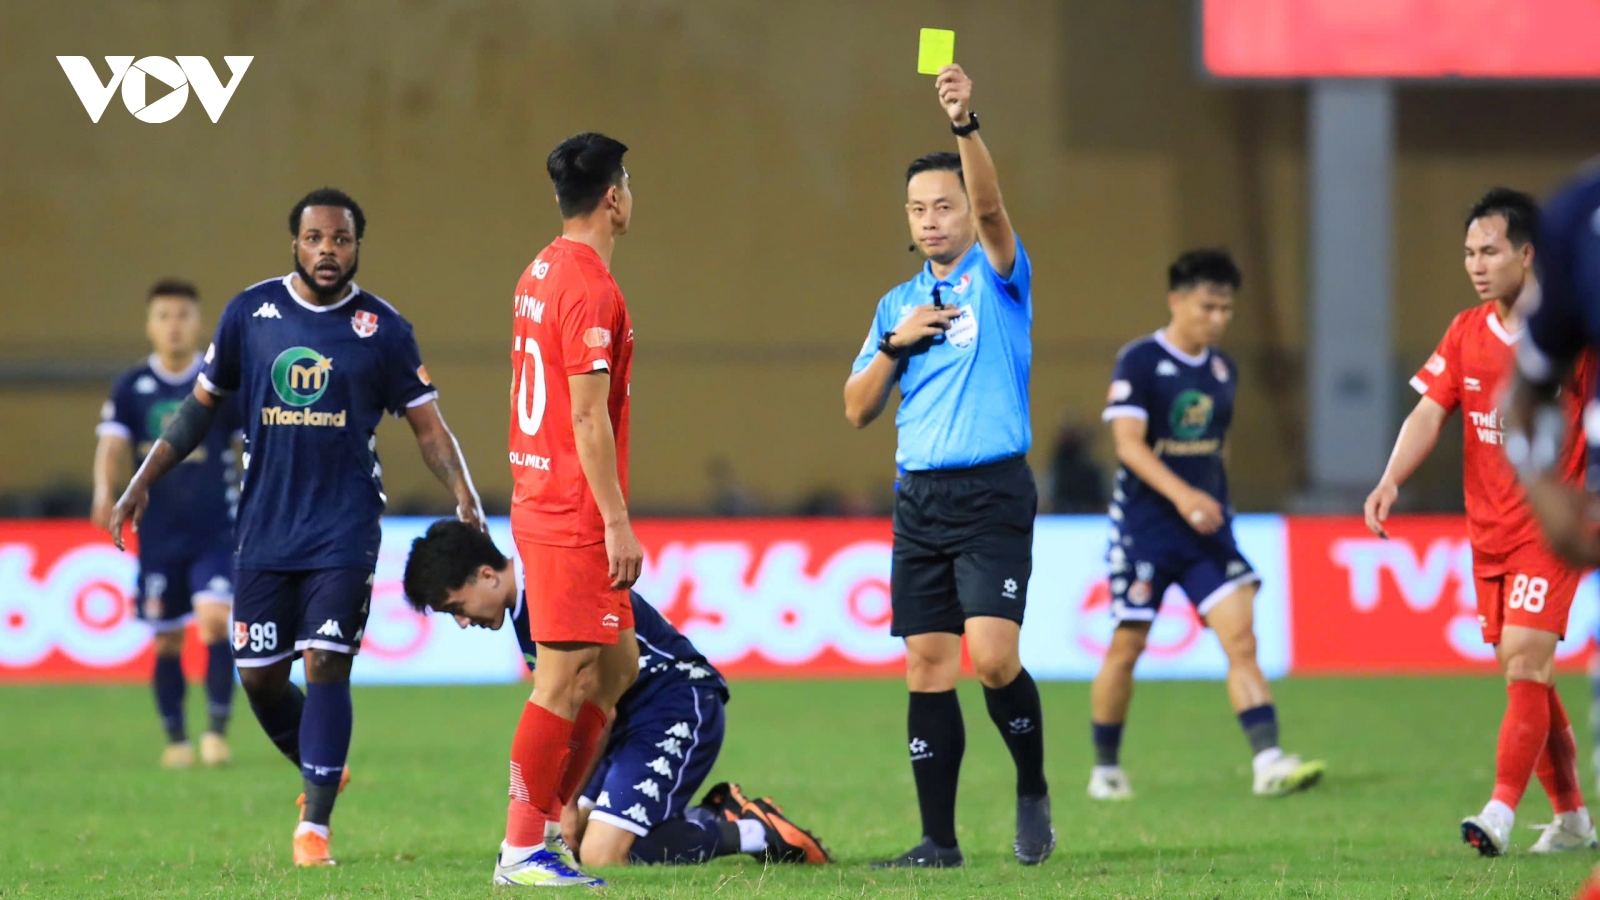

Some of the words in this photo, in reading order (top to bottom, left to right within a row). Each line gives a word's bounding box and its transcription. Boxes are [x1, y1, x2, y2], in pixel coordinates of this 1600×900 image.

[261, 406, 346, 427] Macland
[1476, 426, 1505, 446] VIET
[628, 541, 908, 666] V360
[1508, 573, 1549, 614] 88
[249, 621, 278, 653] 99
